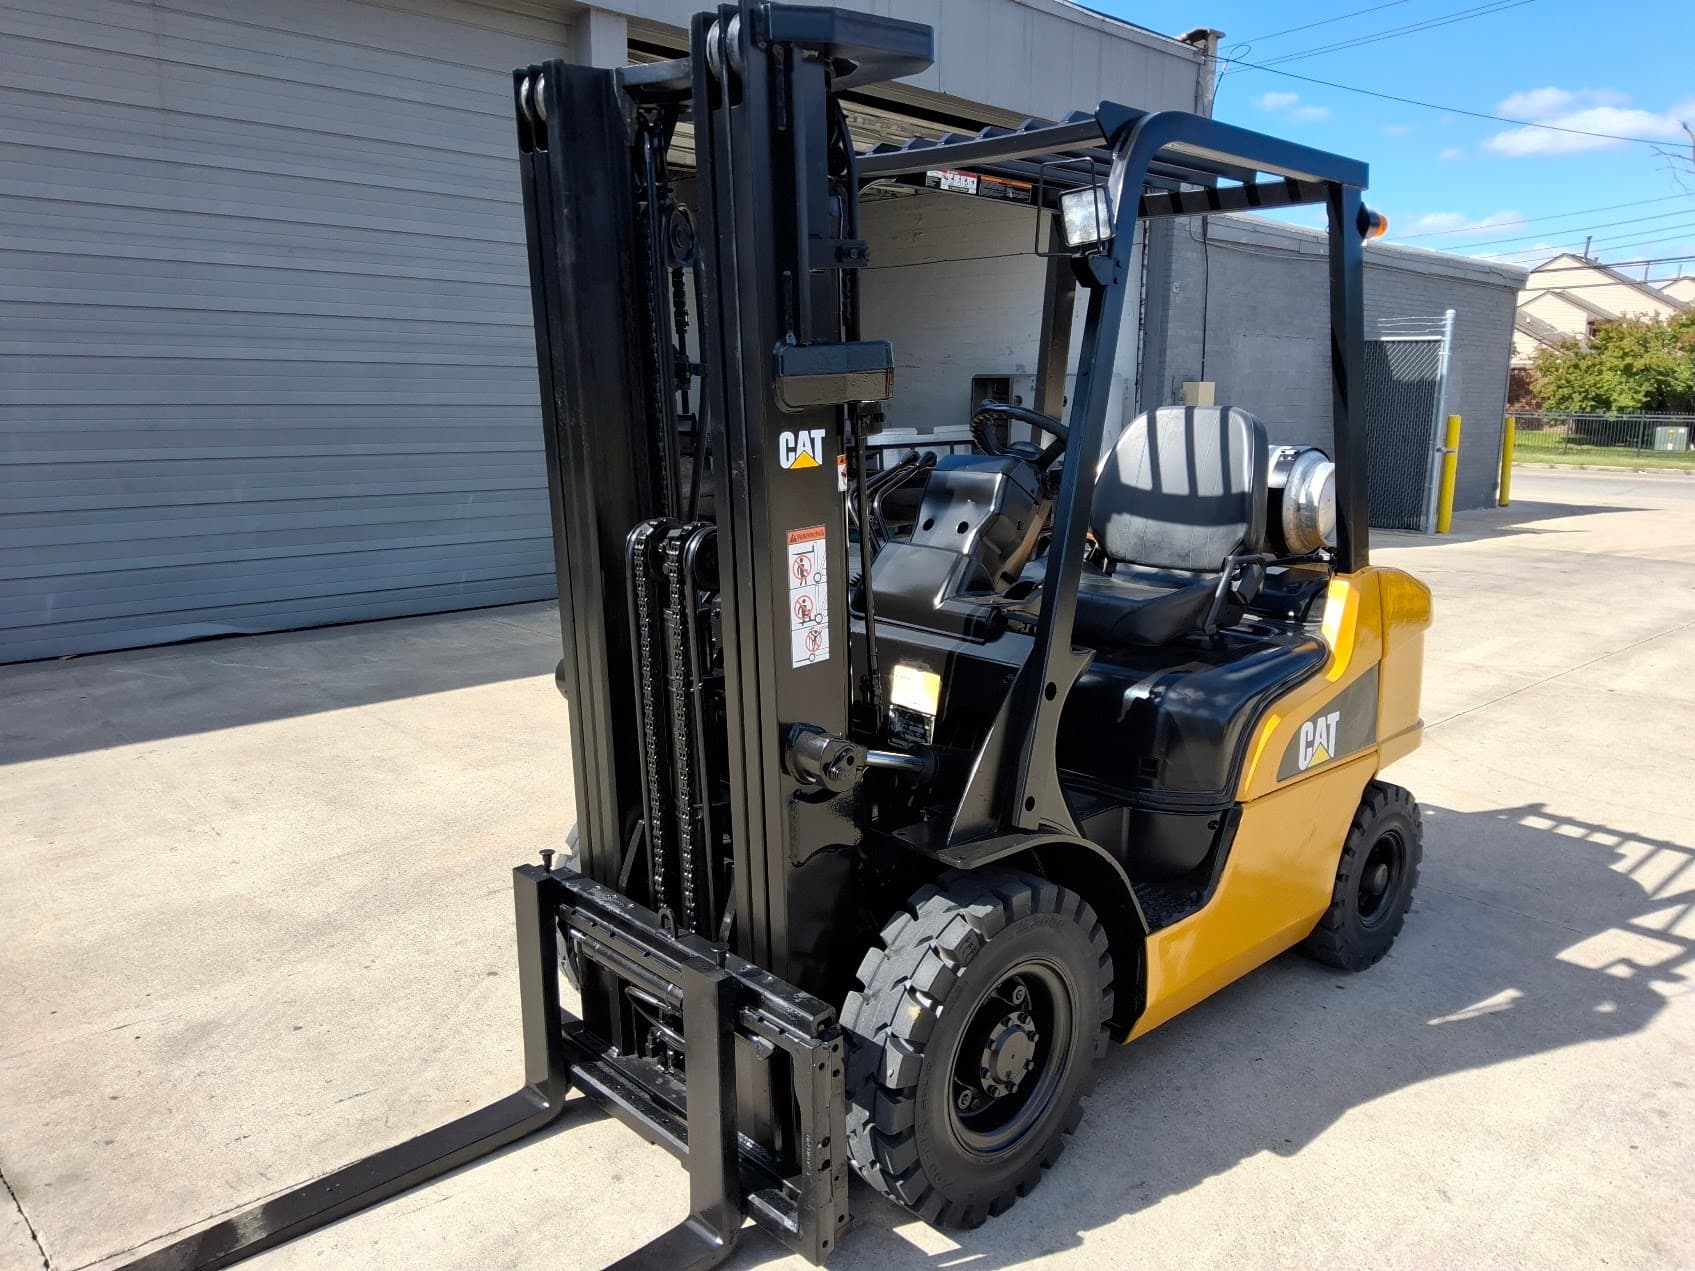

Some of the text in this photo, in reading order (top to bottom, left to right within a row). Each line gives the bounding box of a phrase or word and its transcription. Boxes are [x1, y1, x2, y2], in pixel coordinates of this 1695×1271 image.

[779, 429, 825, 469] CAT
[797, 529, 825, 540] WARNING
[1299, 711, 1340, 770] CAT
